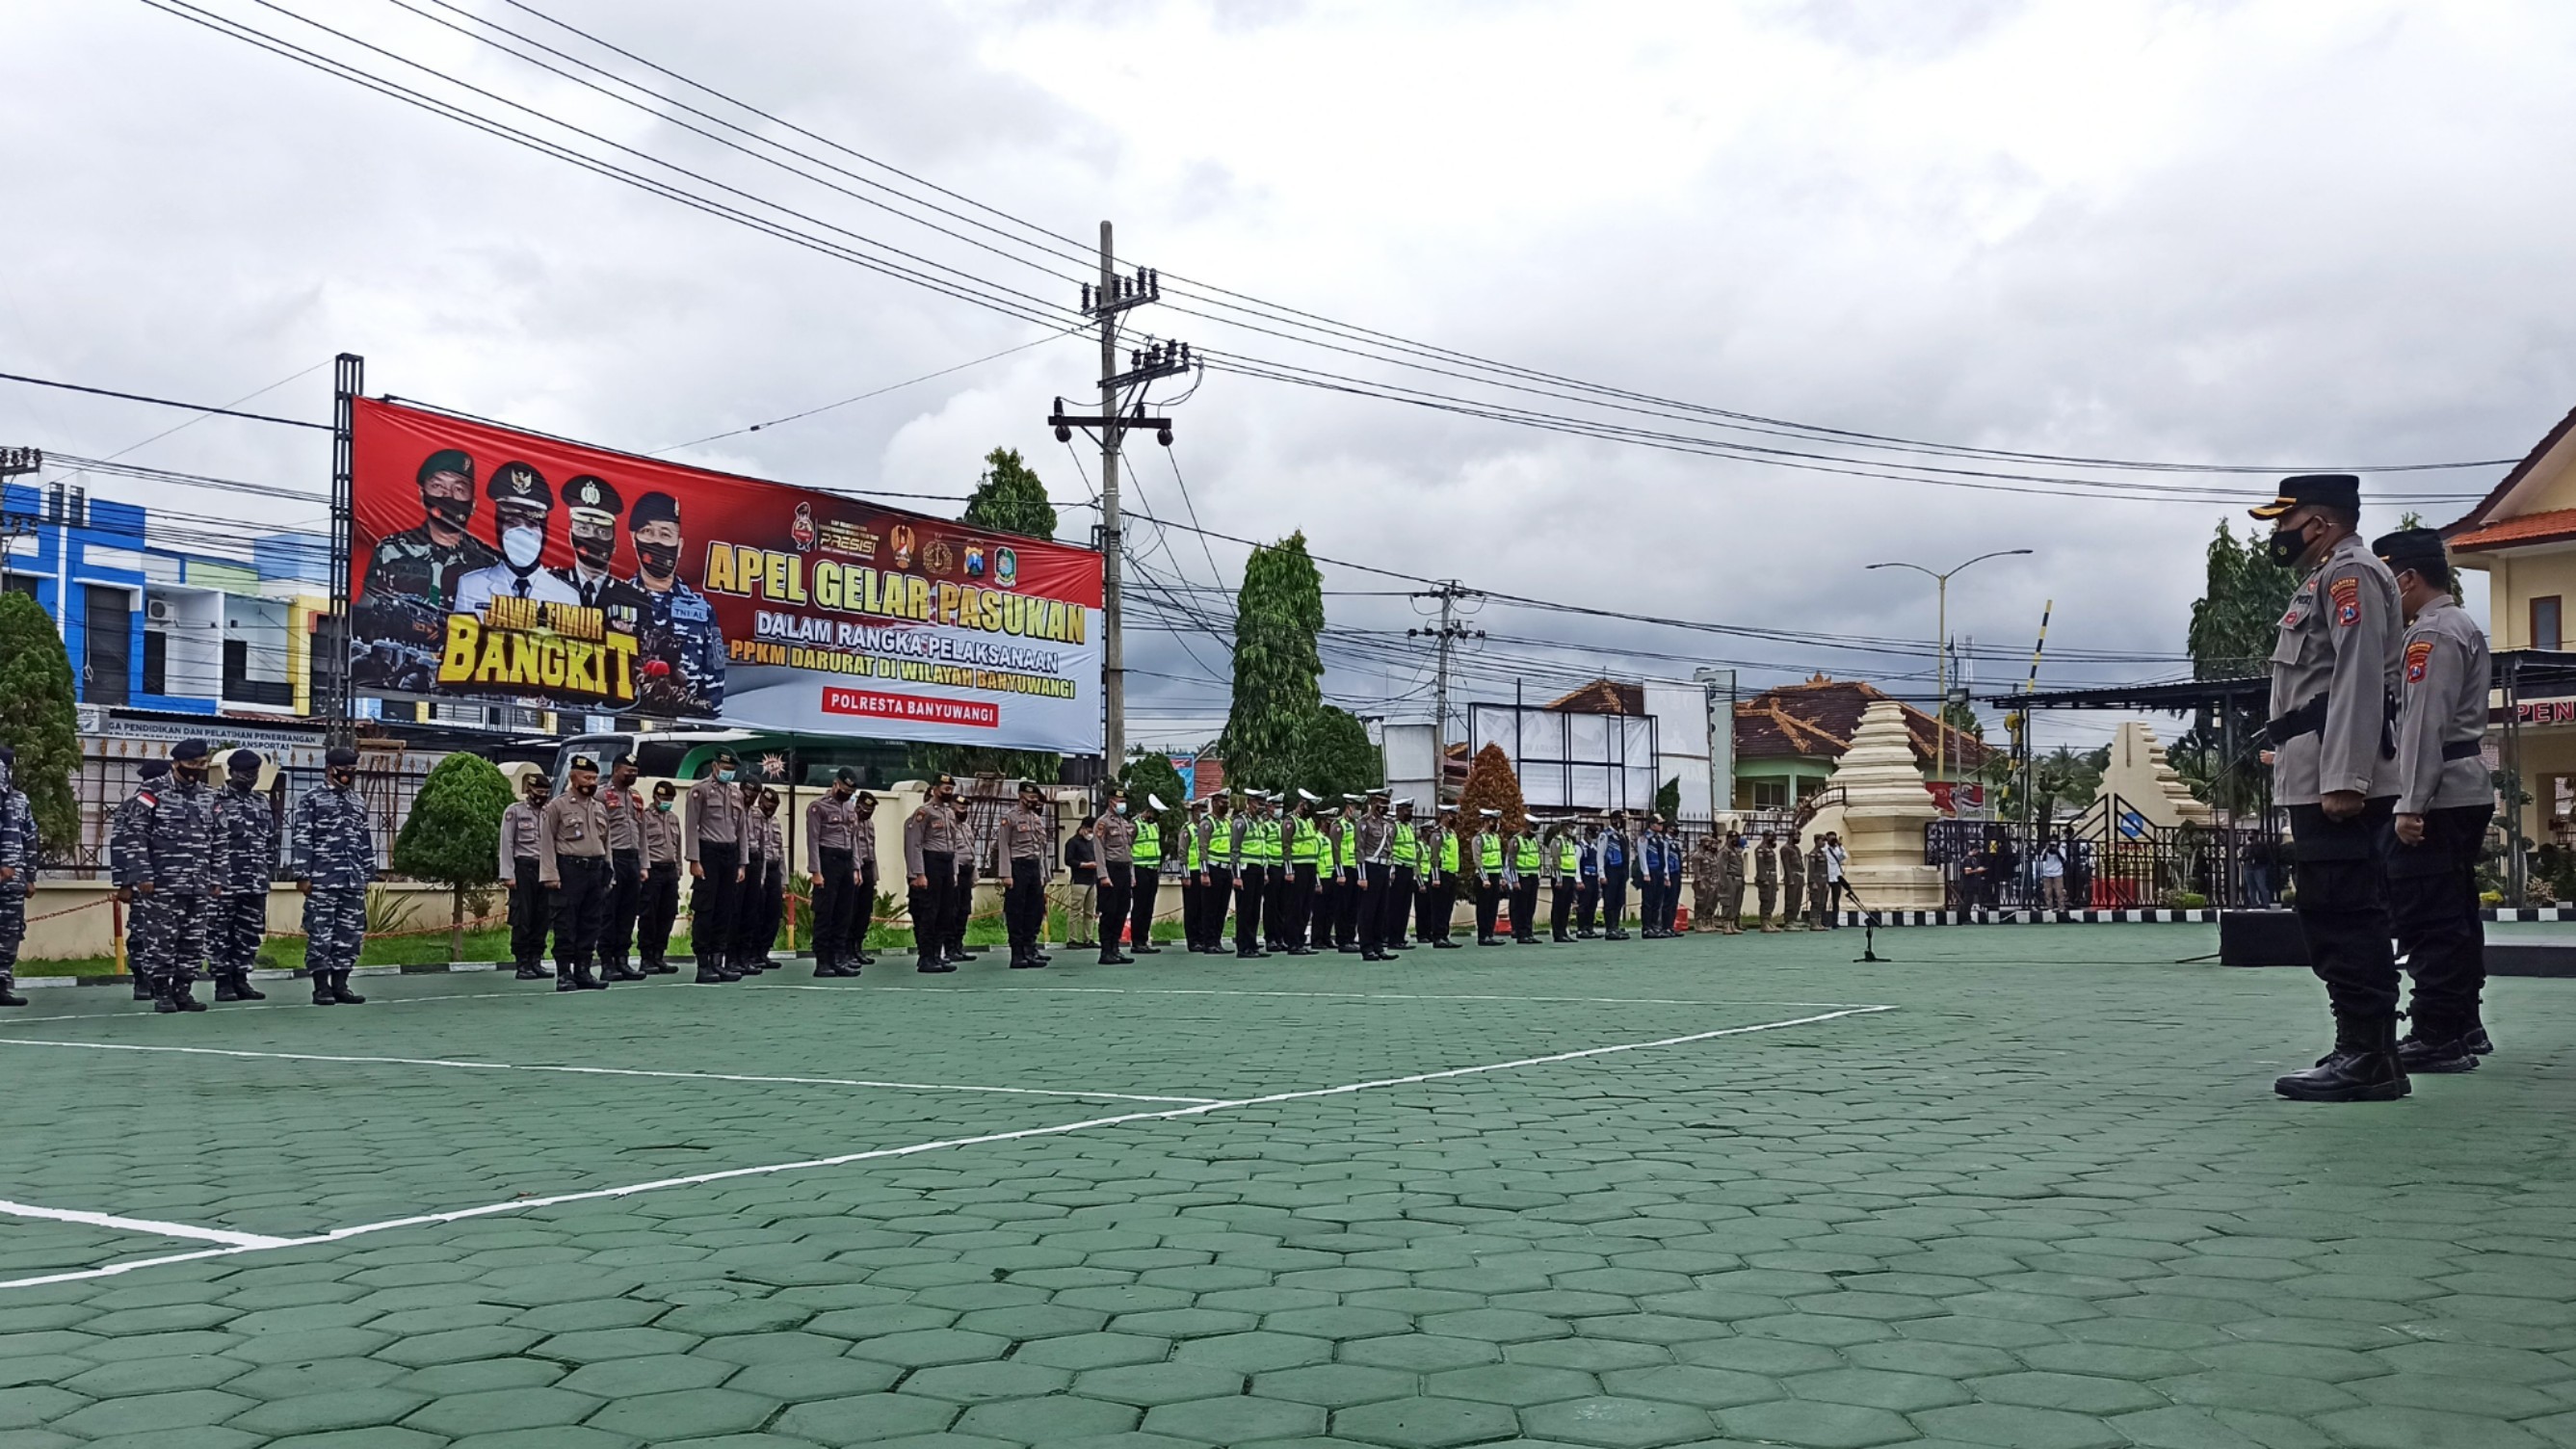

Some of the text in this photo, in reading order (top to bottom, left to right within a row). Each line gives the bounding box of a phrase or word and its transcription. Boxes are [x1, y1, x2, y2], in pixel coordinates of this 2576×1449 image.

[820, 533, 877, 555] PRESISI
[486, 593, 539, 631] JAWA
[546, 601, 604, 640] TIMUR
[673, 608, 704, 620] TNI AL
[703, 541, 1087, 645] APEL GELAR PASUKAN
[436, 613, 640, 702] BANGKIT
[755, 610, 1061, 673] DALAM RANGKA PELAKSANAAN
[729, 638, 1077, 700] PPKM DARURAT DI WILAYAH BANYUWANGI
[831, 693, 995, 723] POLRESTA BANYUWANGI
[124, 723, 183, 735] PENDIDIKAN
[183, 727, 203, 736] DAN
[205, 729, 253, 740] PELATIHAN
[254, 732, 317, 744] PENERBANGAN
